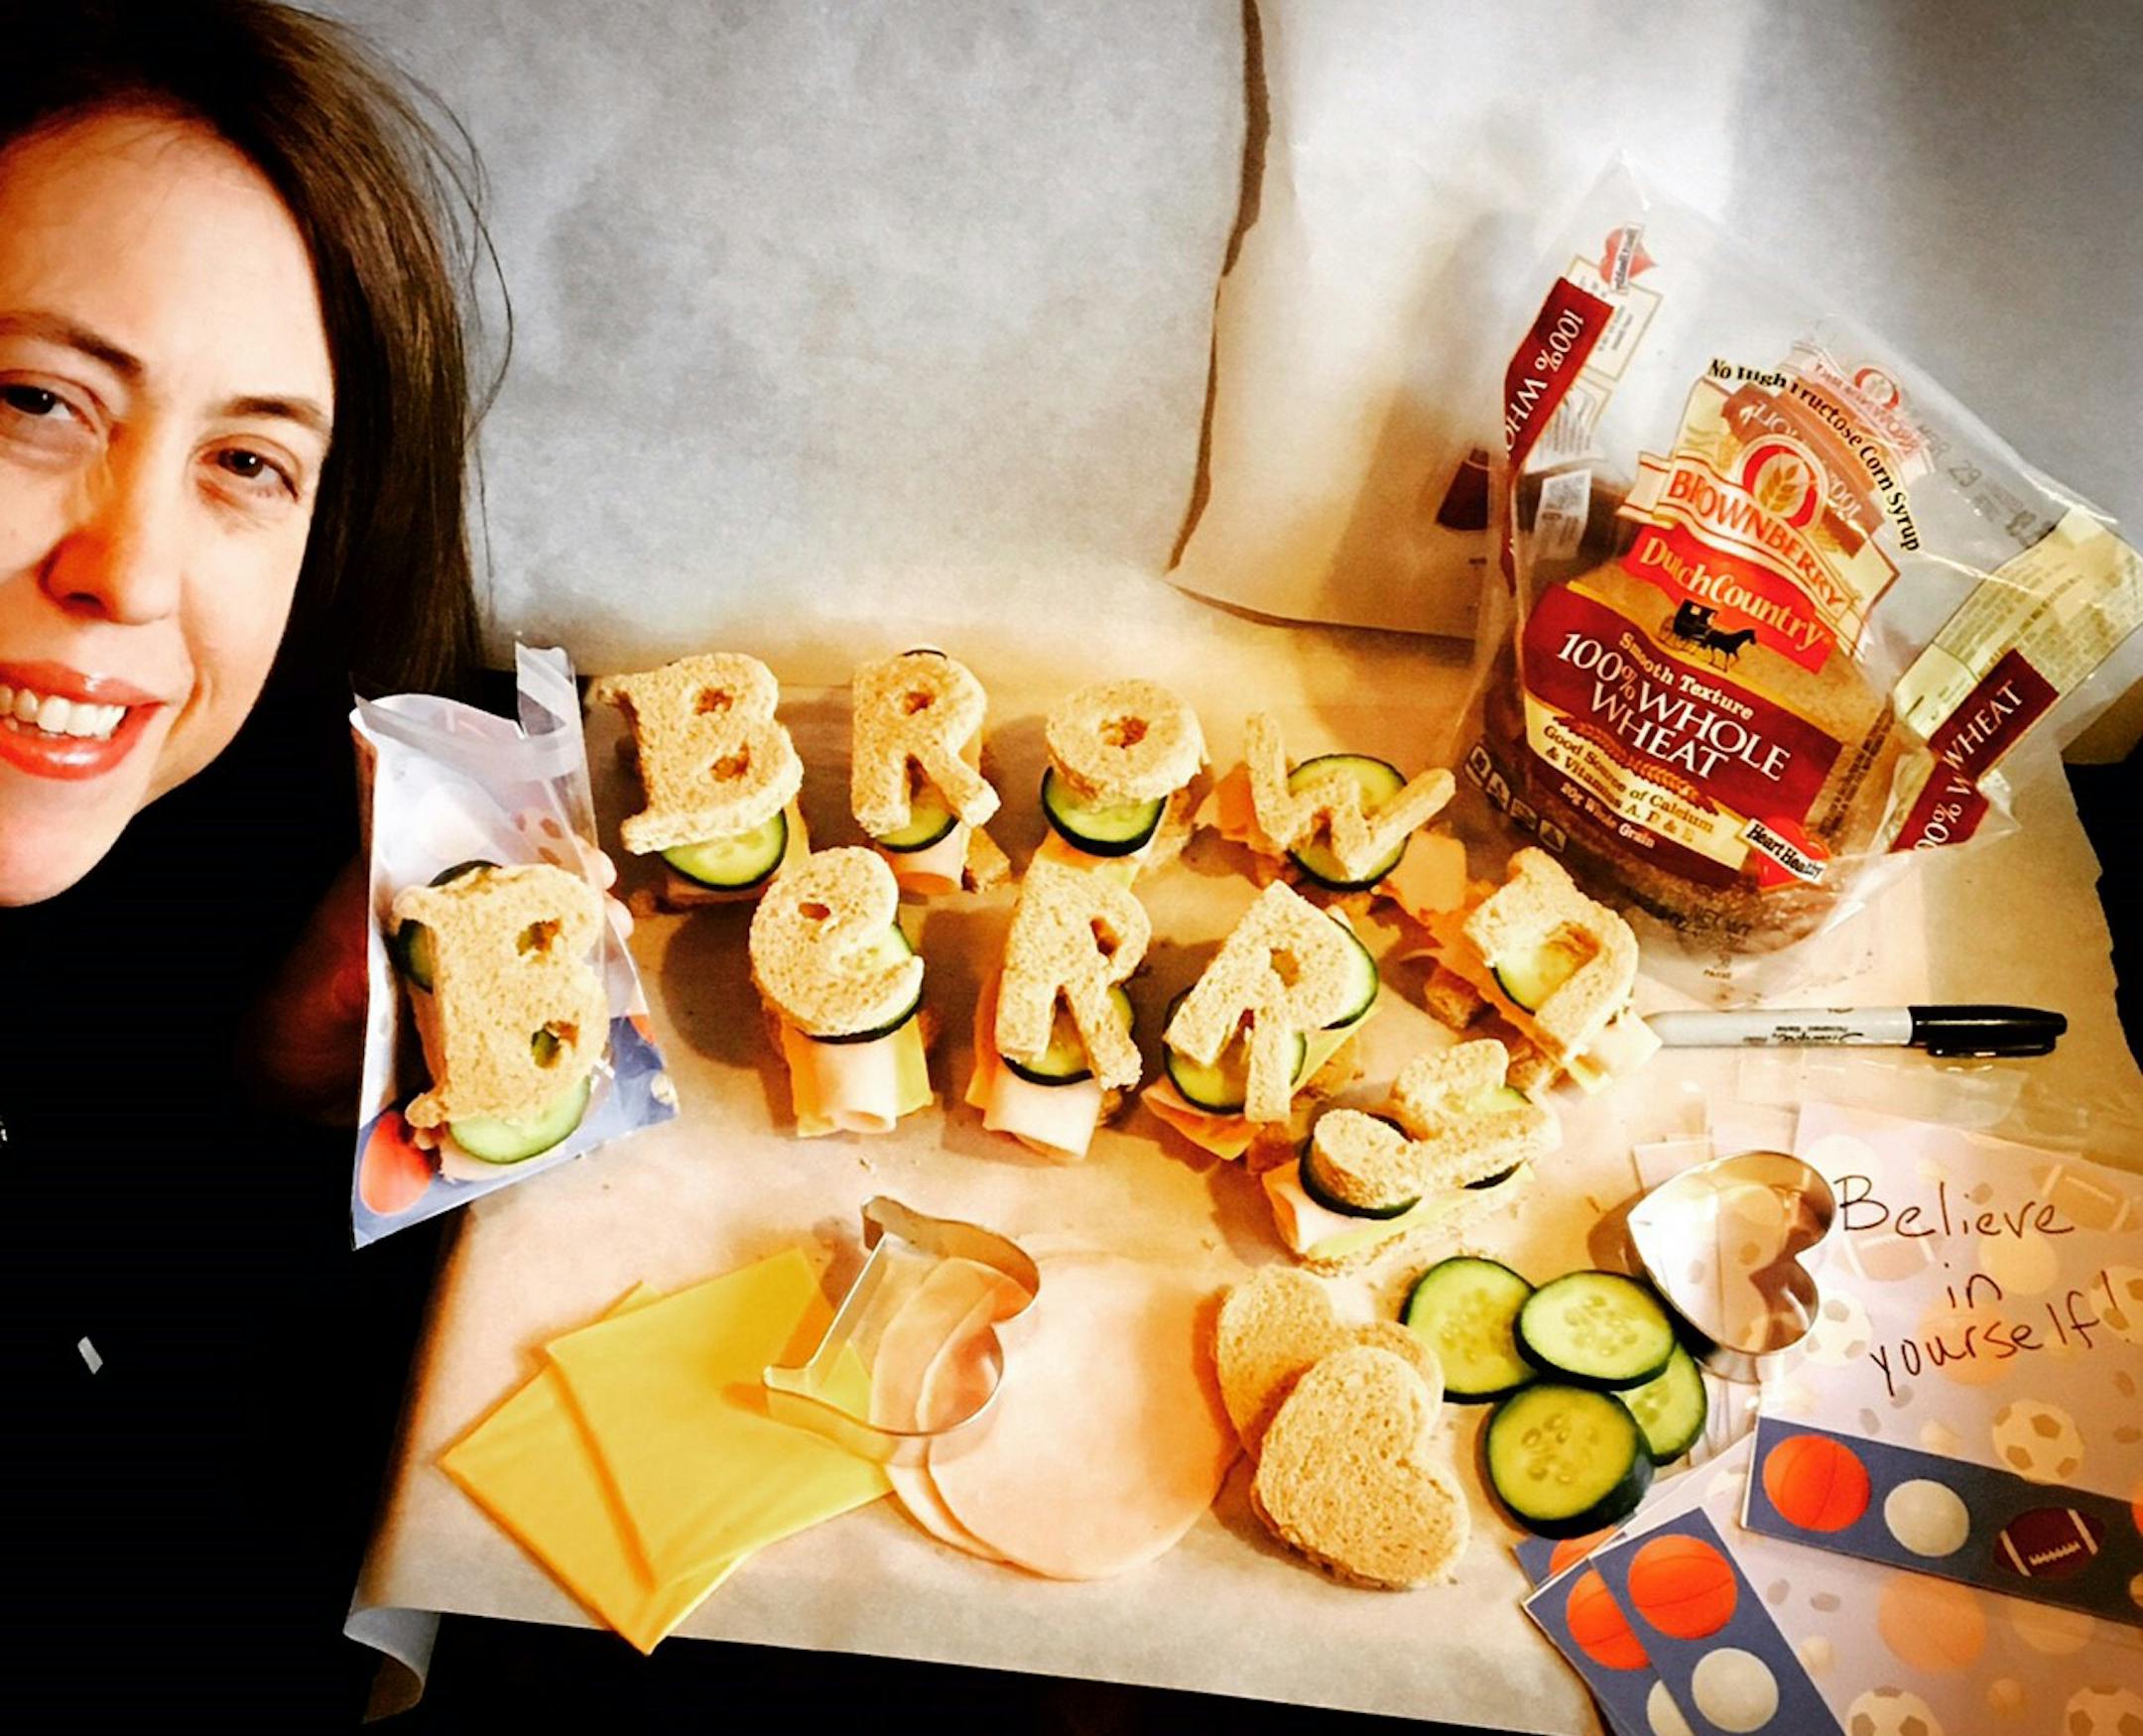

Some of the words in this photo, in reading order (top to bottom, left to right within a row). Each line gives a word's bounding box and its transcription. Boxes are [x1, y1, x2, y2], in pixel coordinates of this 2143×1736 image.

[1535, 309, 1585, 373] 100%
[1708, 359, 1732, 380] No
[1737, 366, 1787, 388] High
[1859, 445, 1895, 492] Corn
[1885, 491, 1921, 553] Syrup
[1557, 633, 1638, 701] 100%
[1639, 681, 1792, 782] WHOLE
[1619, 632, 1676, 685] Smooth
[1679, 675, 1755, 721] Texture
[1590, 681, 1731, 780] WHEAT
[1914, 803, 1964, 851] 00%
[1942, 680, 2024, 771] WHEAT
[1543, 725, 1584, 757] Good
[1583, 751, 1627, 794] Source
[1629, 787, 1650, 801] of
[1649, 794, 1715, 833] Calcium
[1545, 746, 1561, 762] &
[1564, 755, 1623, 809] Vitamins
[1618, 822, 1656, 849] Grain
[1746, 823, 1786, 857] Heart
[1833, 1175, 2076, 1239] Believe
[1944, 1262, 2003, 1309] in
[1869, 1269, 2132, 1399] yourself!
